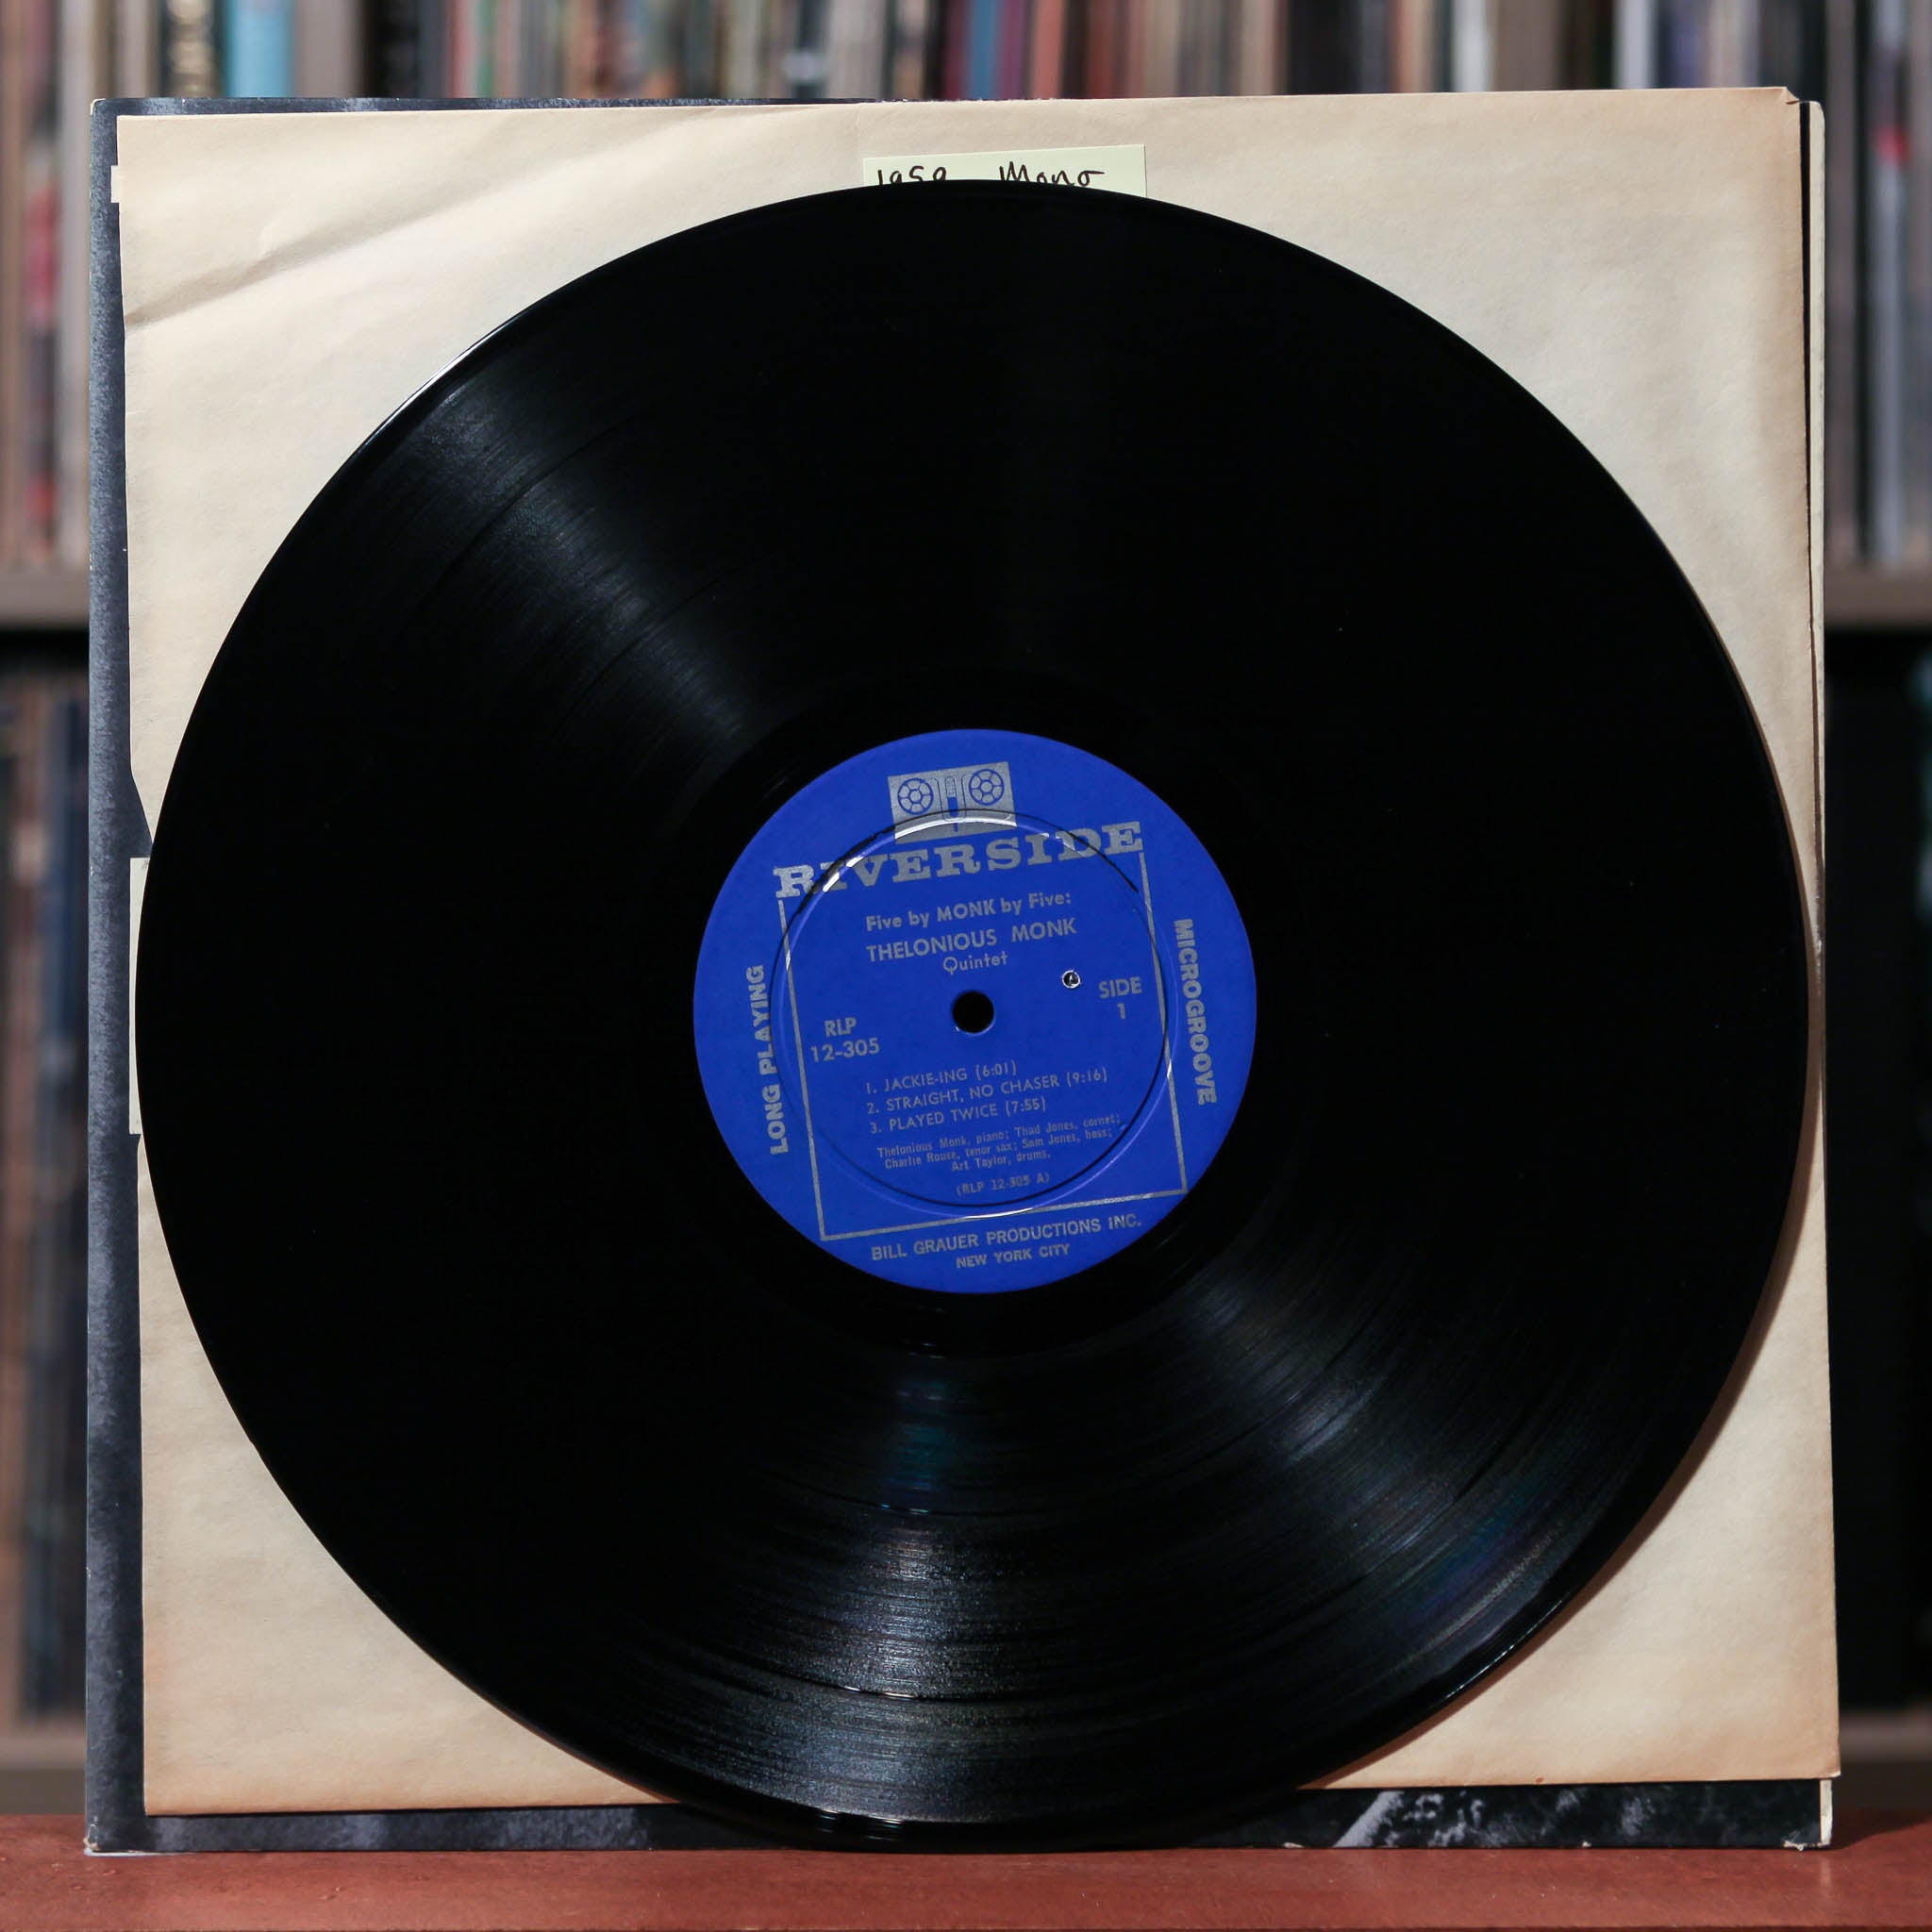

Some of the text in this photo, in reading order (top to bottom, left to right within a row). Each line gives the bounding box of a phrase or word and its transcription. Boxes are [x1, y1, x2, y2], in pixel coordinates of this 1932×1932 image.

[999, 160, 1105, 187] Mono
[773, 821, 1143, 899] RIVERSIDE
[866, 891, 1072, 931] Five by MONK by Five:
[866, 917, 1077, 963] THELONIOUS MONK
[943, 950, 1008, 975] Quintet
[1098, 976, 1142, 999] SIDE
[824, 1017, 858, 1038] RLP
[1117, 1003, 1126, 1020] 1
[1174, 918, 1217, 1106] MICROGROOVE
[745, 964, 789, 1155] LONG PLAYING
[810, 1037, 880, 1062] 12-305
[866, 1059, 1017, 1094] 1. JACKIE-ING (6:01)
[867, 1066, 1108, 1114] 2. STRAIGHT, NO CHASER (9:16)
[869, 1095, 1046, 1134] 3. PLAYED TWICE (7:55)
[876, 1142, 933, 1158] Thelonious
[1014, 1124, 1041, 1137] Thad
[885, 1156, 922, 1170] Charlie
[965, 1145, 991, 1158] tenor
[1022, 1138, 1044, 1149] Sam
[951, 1160, 970, 1172] Art
[956, 1181, 984, 1197] (RLP
[1036, 1172, 1051, 1185] A)
[871, 1213, 1142, 1261] BILL GRAUER PRODUCTIONS INC.
[956, 1242, 1071, 1269] NEW YORK CITY
